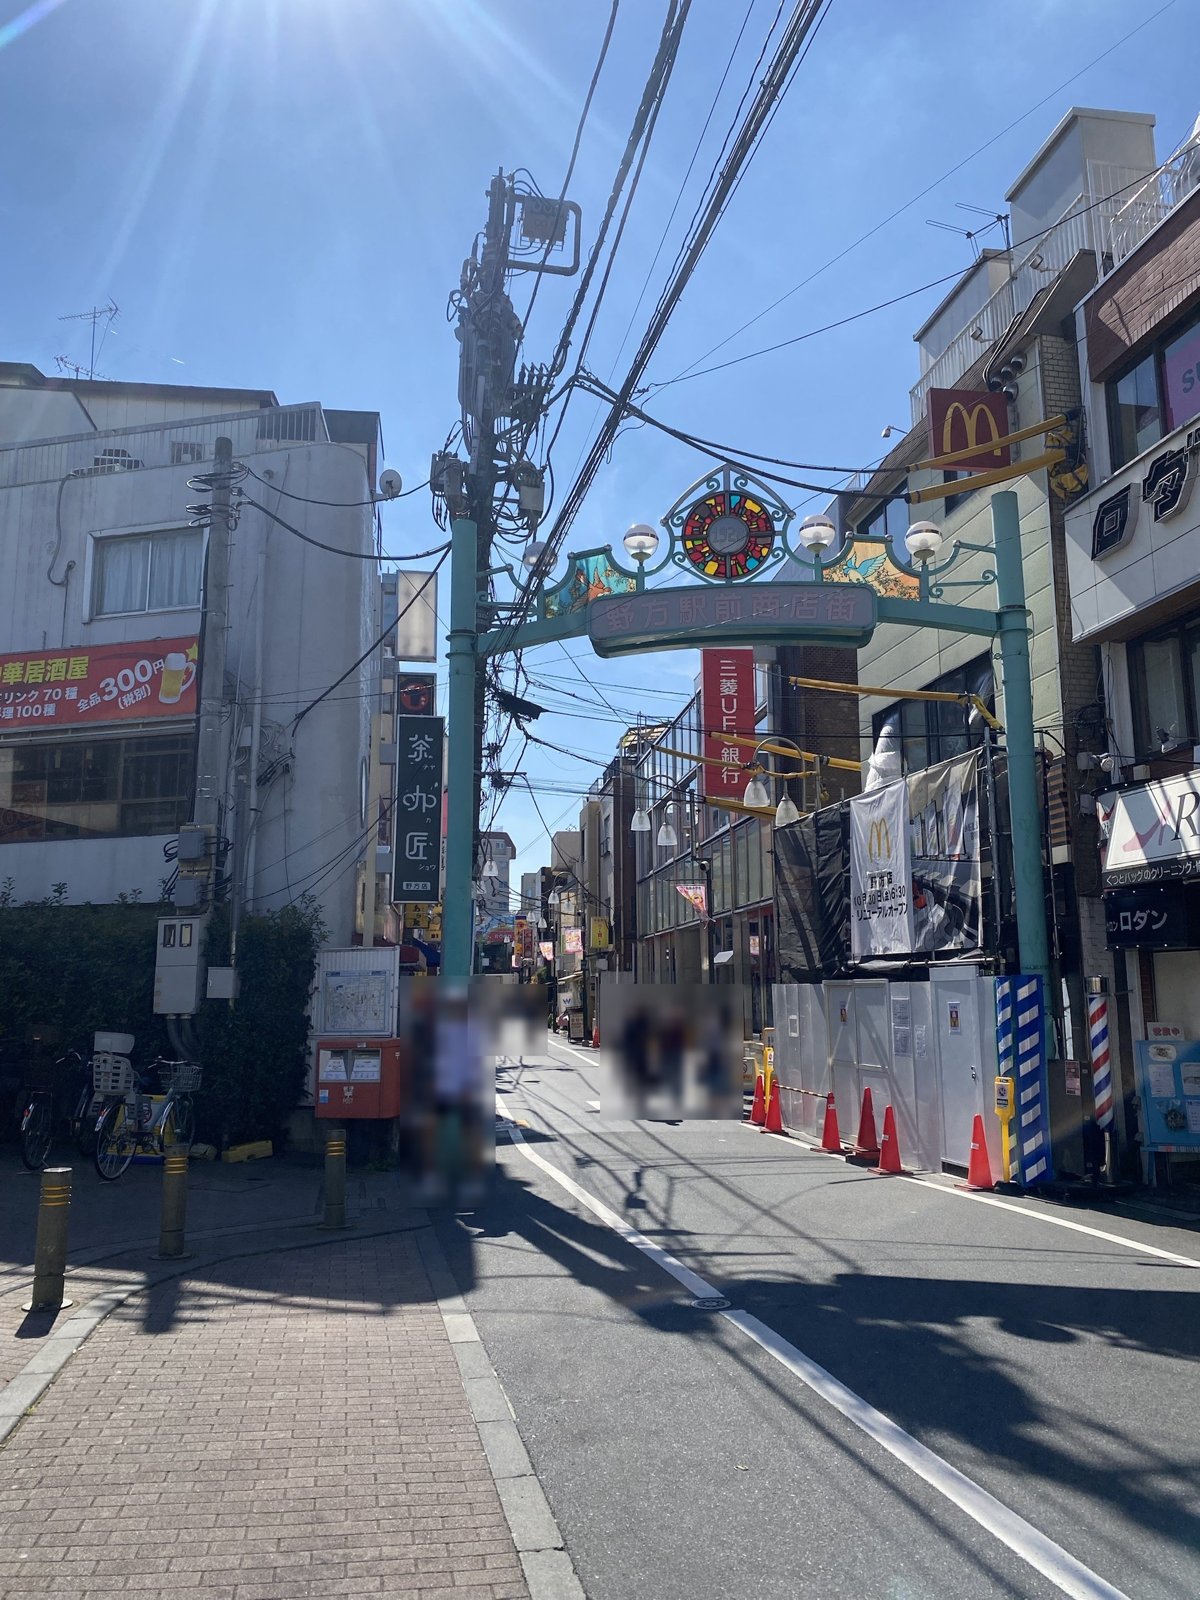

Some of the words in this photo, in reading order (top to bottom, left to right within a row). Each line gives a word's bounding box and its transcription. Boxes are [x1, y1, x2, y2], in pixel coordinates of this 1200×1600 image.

[607, 592, 856, 631] 野方駅前商店街
[0, 656, 89, 686] 華居酒屋
[118, 684, 151, 710] (税別)
[1120, 909, 1168, 931] ロダン
